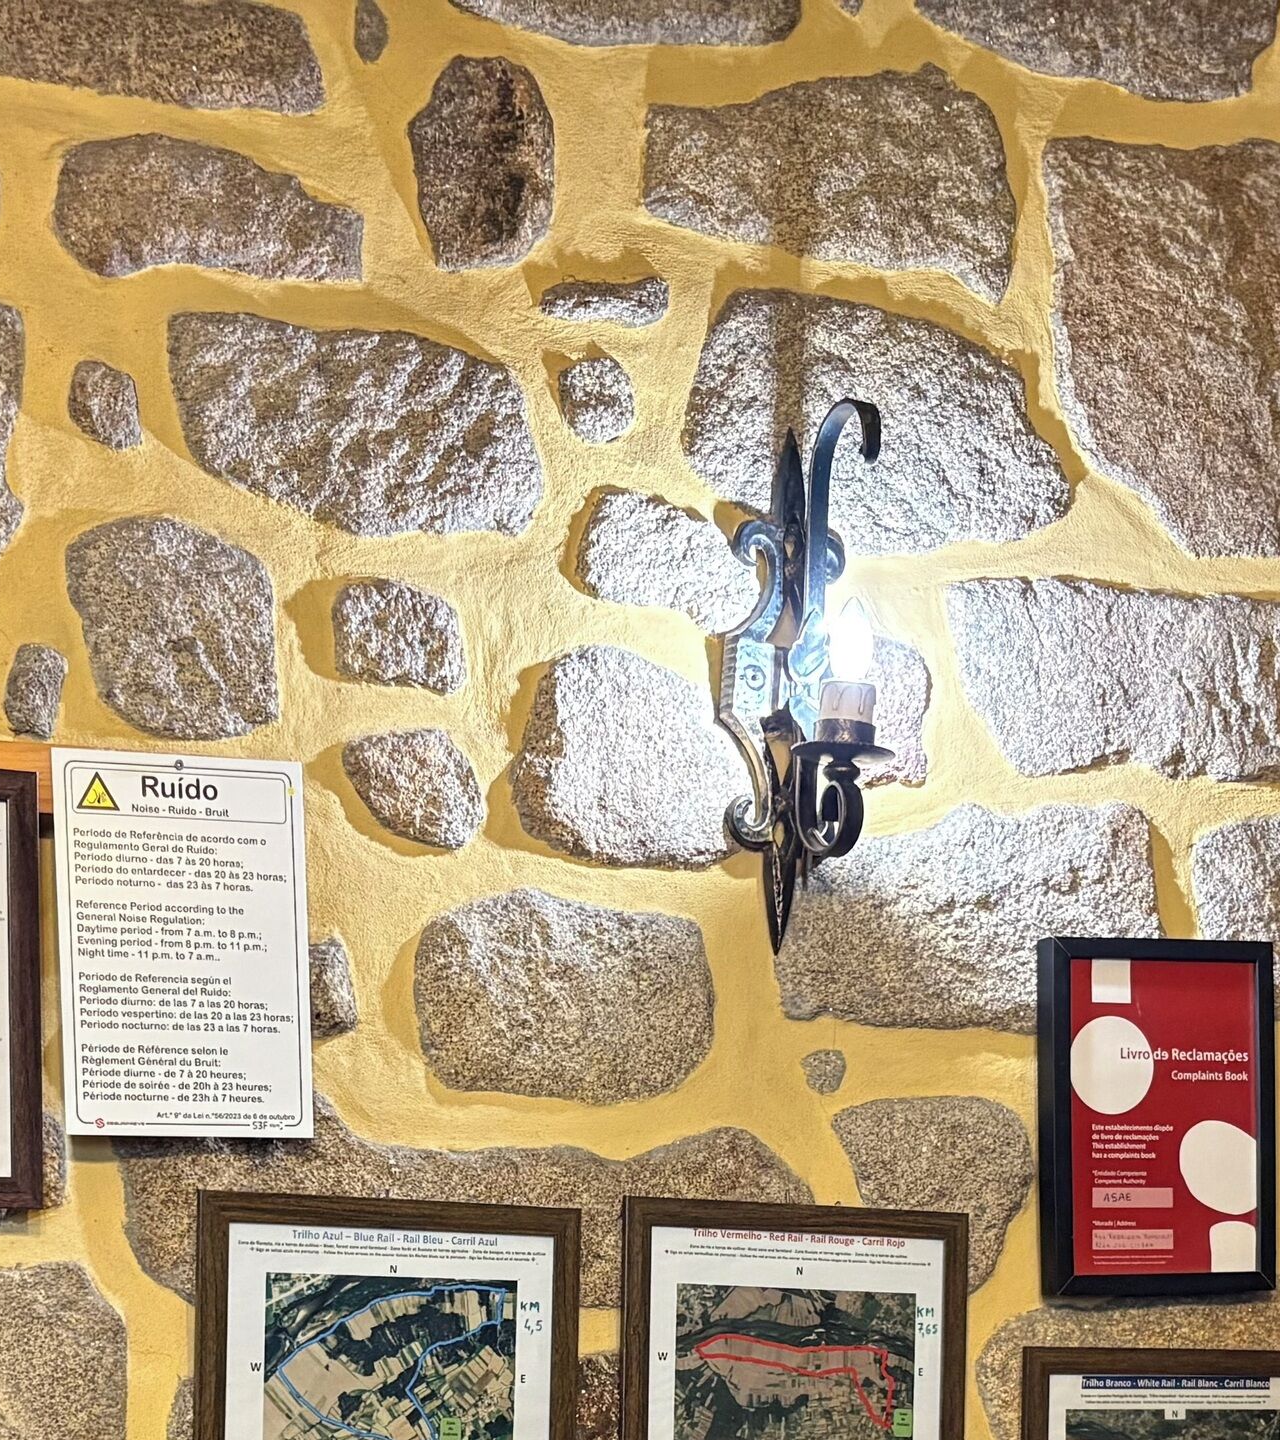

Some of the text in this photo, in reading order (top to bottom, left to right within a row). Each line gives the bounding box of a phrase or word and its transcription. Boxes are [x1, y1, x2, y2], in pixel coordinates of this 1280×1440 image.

[140, 774, 218, 801] Ruído
[131, 803, 229, 817] Noise Ruido Bruit
[129, 829, 183, 841] Referência
[200, 835, 235, 844] acordo
[236, 837, 258, 845] com
[73, 839, 217, 855] Regulamento Geral Ruído:
[114, 853, 147, 863] diurno
[155, 855, 174, 864] das
[212, 857, 243, 869] horas;
[130, 866, 186, 877] entardecer
[193, 868, 212, 878] das
[256, 871, 287, 883] horas;
[116, 878, 155, 887] noturno
[165, 879, 184, 889] das
[222, 881, 253, 892] horas.
[75, 899, 244, 915] Reference Period according the
[76, 911, 204, 926] General Noise Regulation:
[76, 923, 261, 940] Daytime period from a.m. p.m.;
[77, 935, 267, 952] Evening period from p.m. p.m.;
[77, 947, 105, 959] Night
[106, 948, 129, 958] time
[151, 951, 173, 961] p.m.
[134, 972, 188, 984] Referencia
[190, 975, 220, 986] según
[78, 983, 231, 997] Reglamento General del Ruido:
[120, 996, 156, 1006] diurno:
[172, 997, 188, 1007] las
[206, 999, 221, 1008] las
[237, 1000, 268, 1011] horas;
[120, 1009, 293, 1023] vespertino: las las horas;
[121, 1021, 169, 1030] nocturno:
[186, 1022, 201, 1031] las
[203, 1022, 215, 1032] 23
[225, 1022, 240, 1032] las
[250, 1024, 280, 1033] horas.
[122, 1044, 135, 1053] de
[190, 1046, 217, 1055] selon
[219, 1046, 228, 1055] le
[1120, 1047, 1249, 1064] Livro de Reclamações
[81, 1055, 221, 1067] Règlement Général du Bruit:
[123, 1067, 155, 1077] diurne
[163, 1068, 176, 1078] de
[195, 1069, 207, 1078] 20
[209, 1069, 246, 1080] heures;
[1171, 1070, 1248, 1082] Complaints Book
[123, 1079, 136, 1089] de
[138, 1080, 170, 1089] soirée
[177, 1081, 190, 1090] de
[192, 1081, 211, 1090] 20h
[221, 1081, 233, 1091] 23
[235, 1082, 271, 1092] heures;
[123, 1092, 169, 1101] nocturne
[176, 1092, 189, 1102] de
[191, 1092, 210, 1102] 23h
[228, 1093, 264, 1103] heures.
[292, 1230, 498, 1246] Trilho Azul Blue Rail Rail Bleu Carril Azul
[693, 1229, 905, 1248] Trilho Vermelho Red Rail Rail Rouge Carril Rojo
[390, 1265, 398, 1274] N
[796, 1266, 803, 1276] N
[520, 1301, 540, 1312] KM
[917, 1307, 934, 1318] KM
[657, 1352, 668, 1361] W
[250, 1362, 262, 1372] W
[918, 1368, 923, 1376] E
[520, 1375, 526, 1383] E
[1082, 1379, 1270, 1388] Trilho Branco White Rail Rail Blanc Carril Blanco
[1172, 1410, 1178, 1418] N
